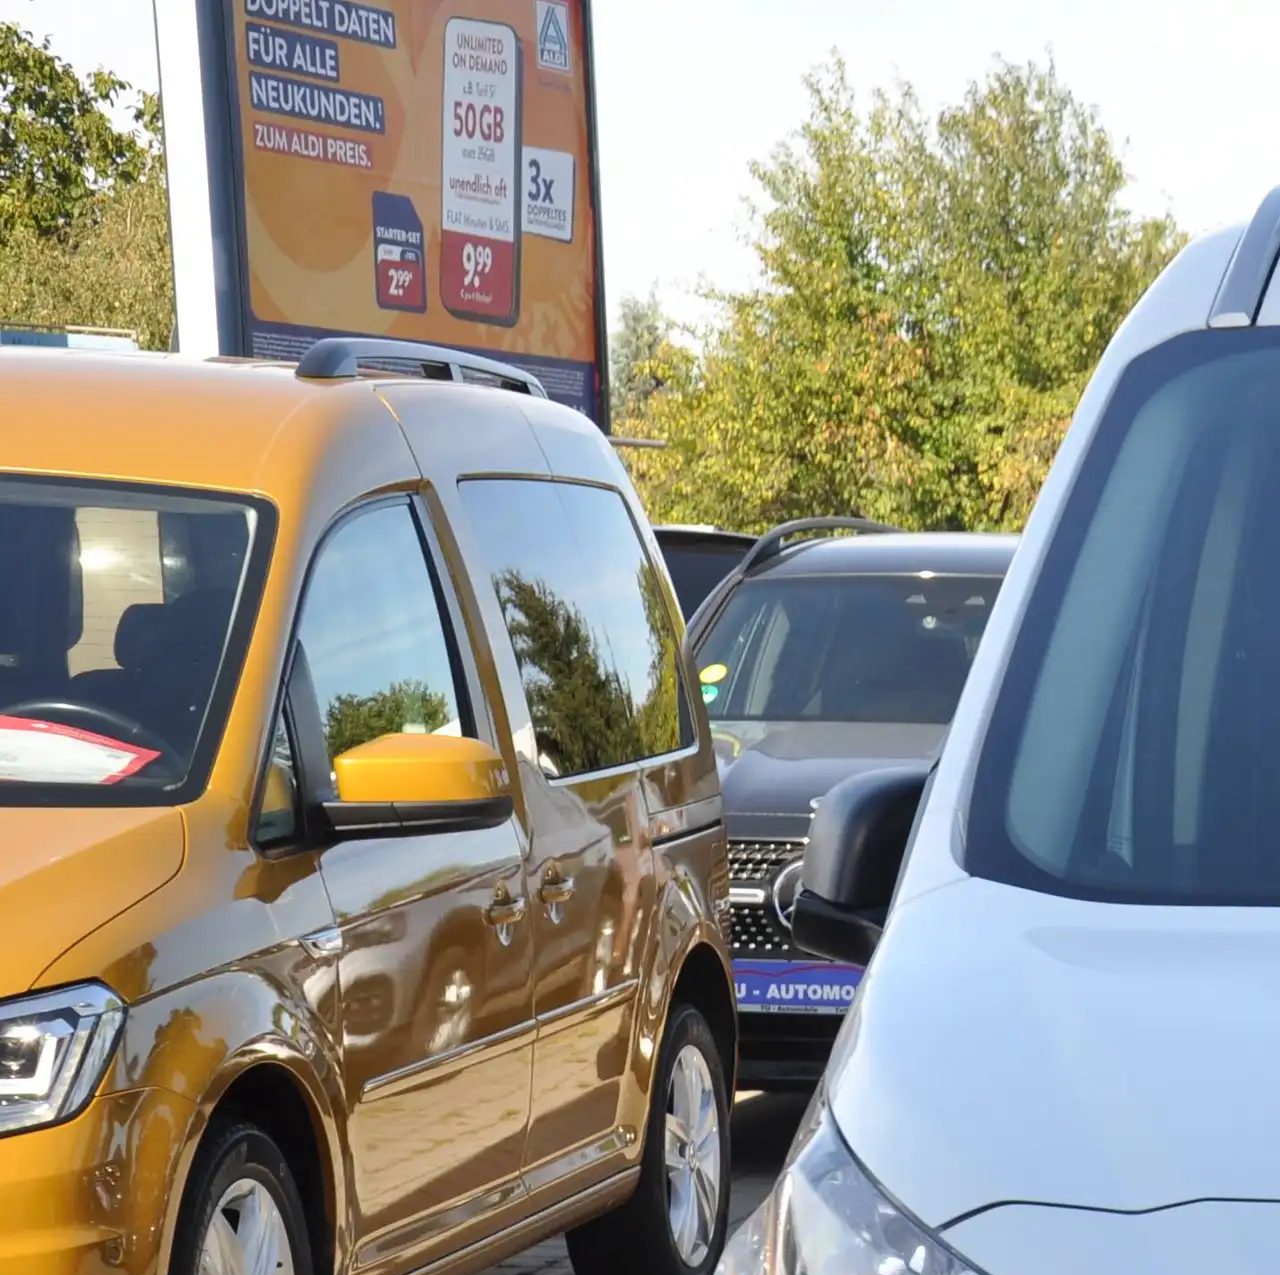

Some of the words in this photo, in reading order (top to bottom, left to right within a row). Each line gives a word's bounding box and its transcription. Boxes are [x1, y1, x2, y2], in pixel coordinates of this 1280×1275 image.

[334, 3, 395, 45] DATEN
[248, 27, 288, 67] FÜR
[293, 42, 338, 78] ALLE
[457, 31, 504, 55] UNLIMITED
[452, 52, 466, 69] ON
[469, 54, 508, 76] DEMAND
[255, 124, 288, 153] ZUM
[291, 132, 323, 159] ALDI
[327, 138, 372, 168] PREIS.
[449, 173, 493, 195] unendlich
[495, 177, 507, 199] oft
[375, 226, 421, 245] STARTER-SET
[766, 983, 858, 1001] AUTOMO
